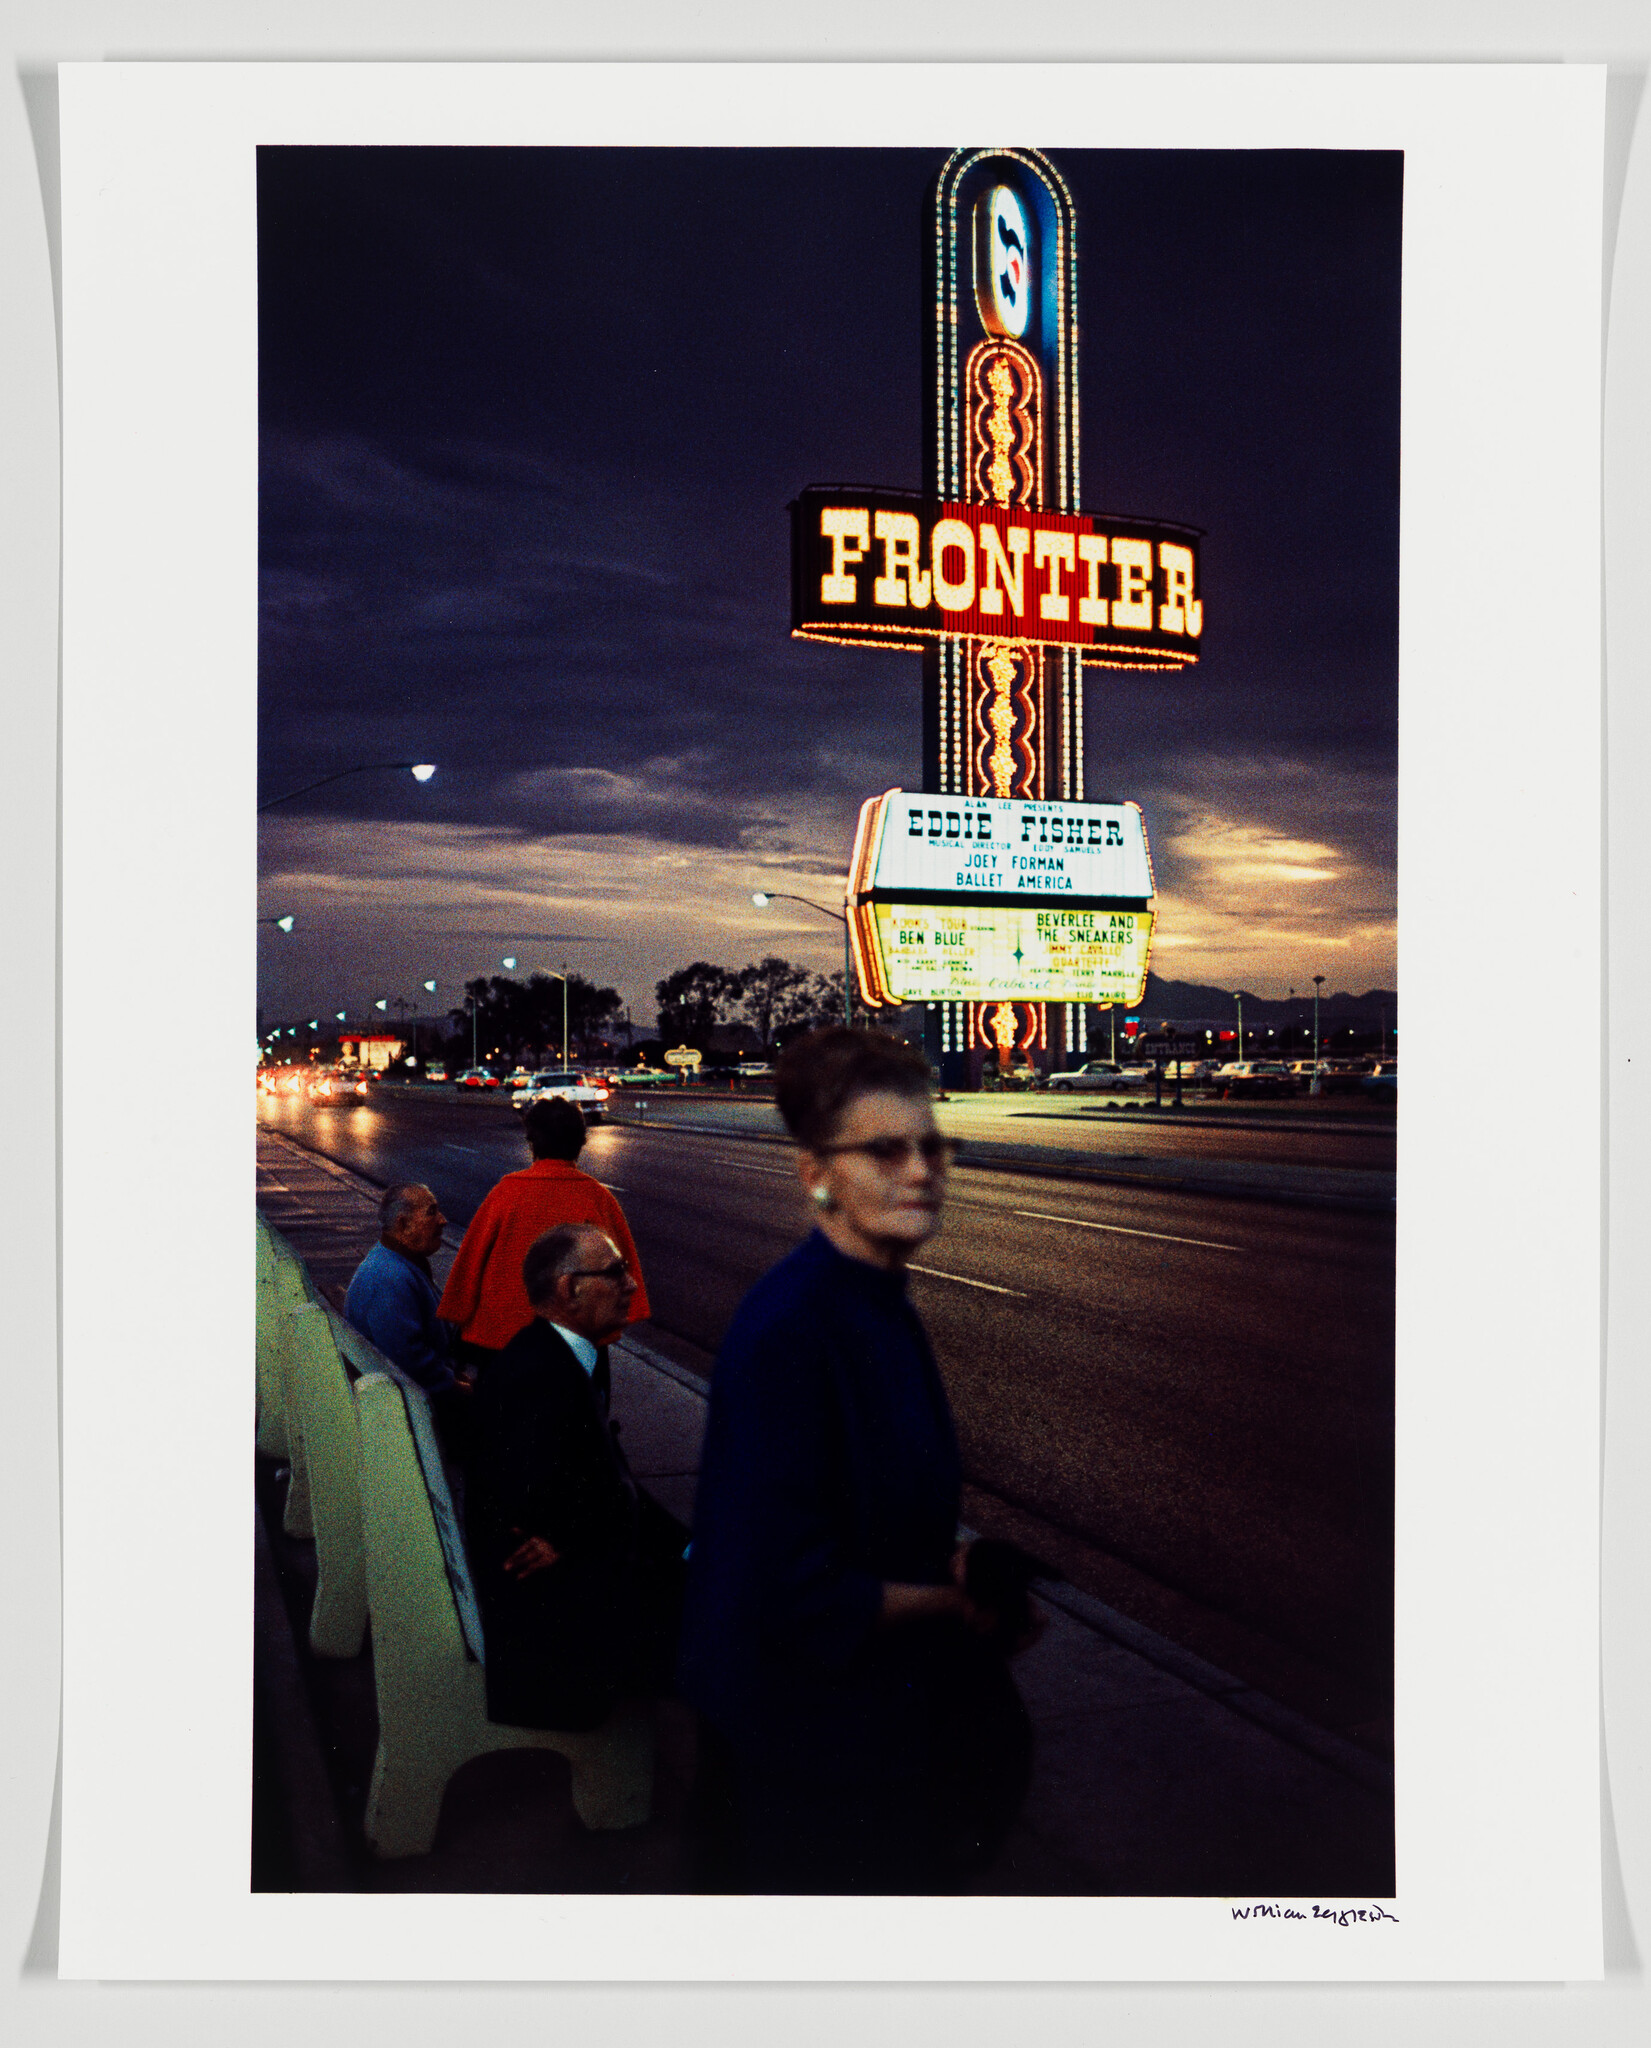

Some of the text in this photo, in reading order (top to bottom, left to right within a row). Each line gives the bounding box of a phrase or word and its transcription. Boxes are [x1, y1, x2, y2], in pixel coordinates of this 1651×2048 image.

[820, 506, 1203, 638] FRONTIER
[964, 800, 1064, 812] ALAN LEE PRESENTS
[908, 809, 1124, 846] EDDIE FISHER
[928, 839, 965, 848] MUSICAL
[972, 841, 1012, 850] DIRECTOR
[1064, 846, 1102, 854] SAMUELS
[964, 853, 1064, 871] JOEY FORMAN
[956, 872, 1073, 890] BALLET AMERICA
[1036, 913, 1134, 929] BEVERLEE AND
[899, 931, 966, 946] BEN BLUE
[1036, 928, 1134, 944] THE SNEAKERS
